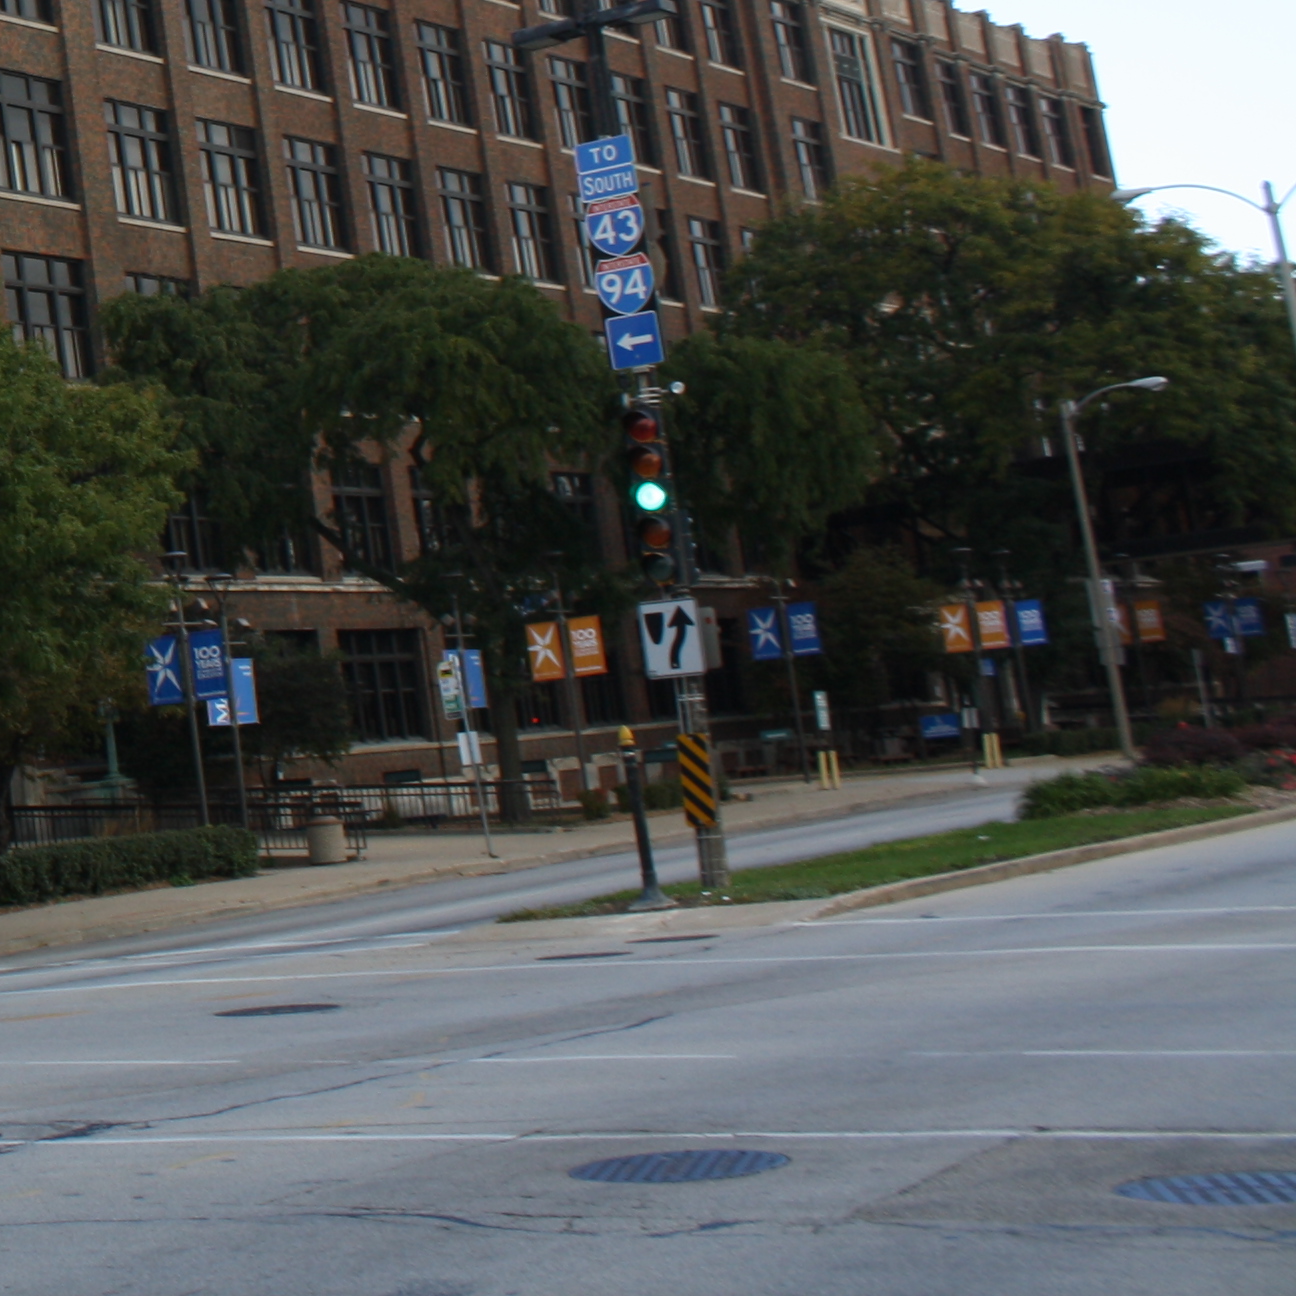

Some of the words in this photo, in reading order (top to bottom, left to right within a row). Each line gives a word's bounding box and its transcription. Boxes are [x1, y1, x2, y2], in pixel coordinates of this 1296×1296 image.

[589, 145, 617, 163] TO
[583, 171, 634, 196] SOUTH
[594, 209, 640, 245] 43
[601, 268, 647, 304] 94
[570, 628, 596, 640] 100
[193, 645, 221, 659] 100
